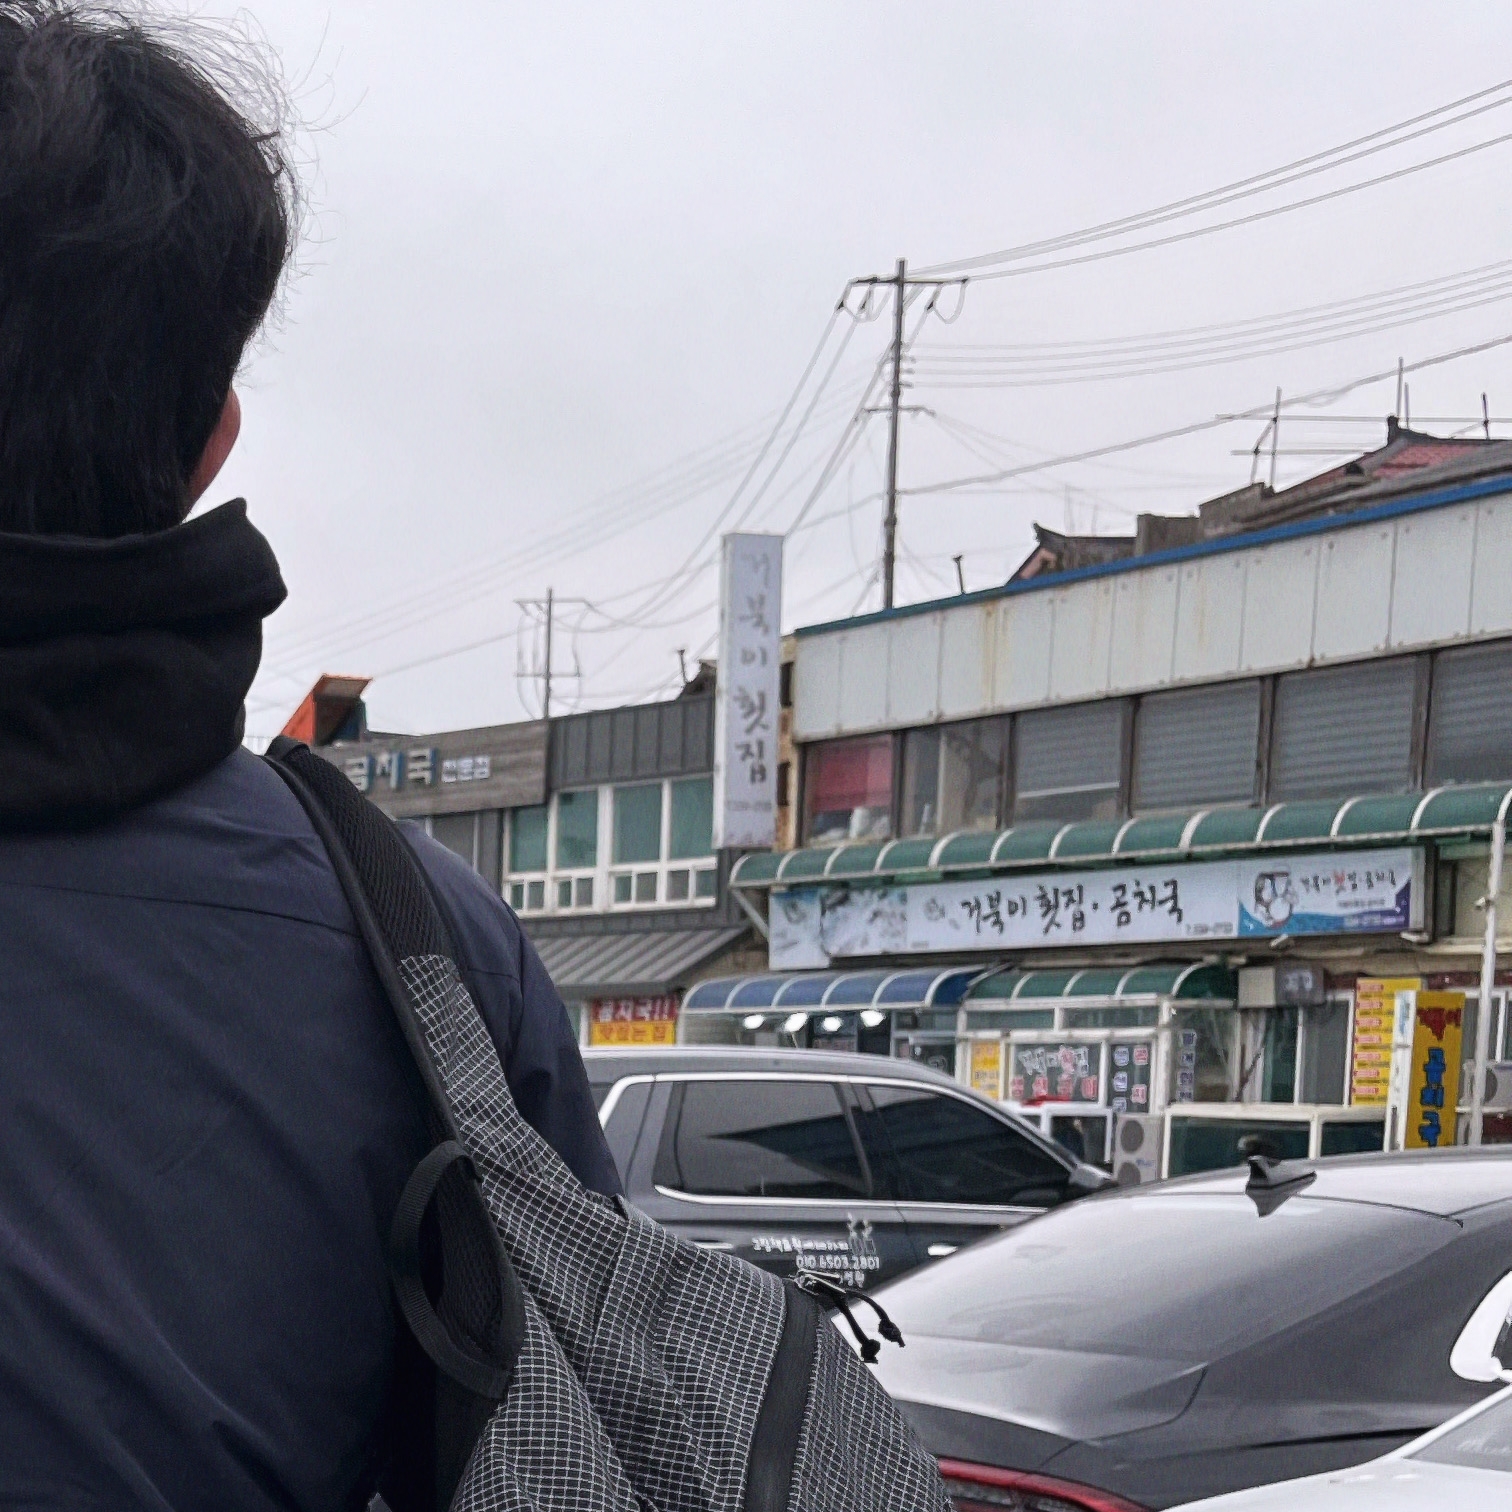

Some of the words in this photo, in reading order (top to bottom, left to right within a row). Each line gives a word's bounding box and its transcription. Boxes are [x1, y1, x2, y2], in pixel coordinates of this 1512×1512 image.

[734, 684, 769, 786] 횟집
[960, 888, 1028, 935] 거북이
[1035, 883, 1086, 936] 횟집
[1109, 878, 1184, 924] 곰치국
